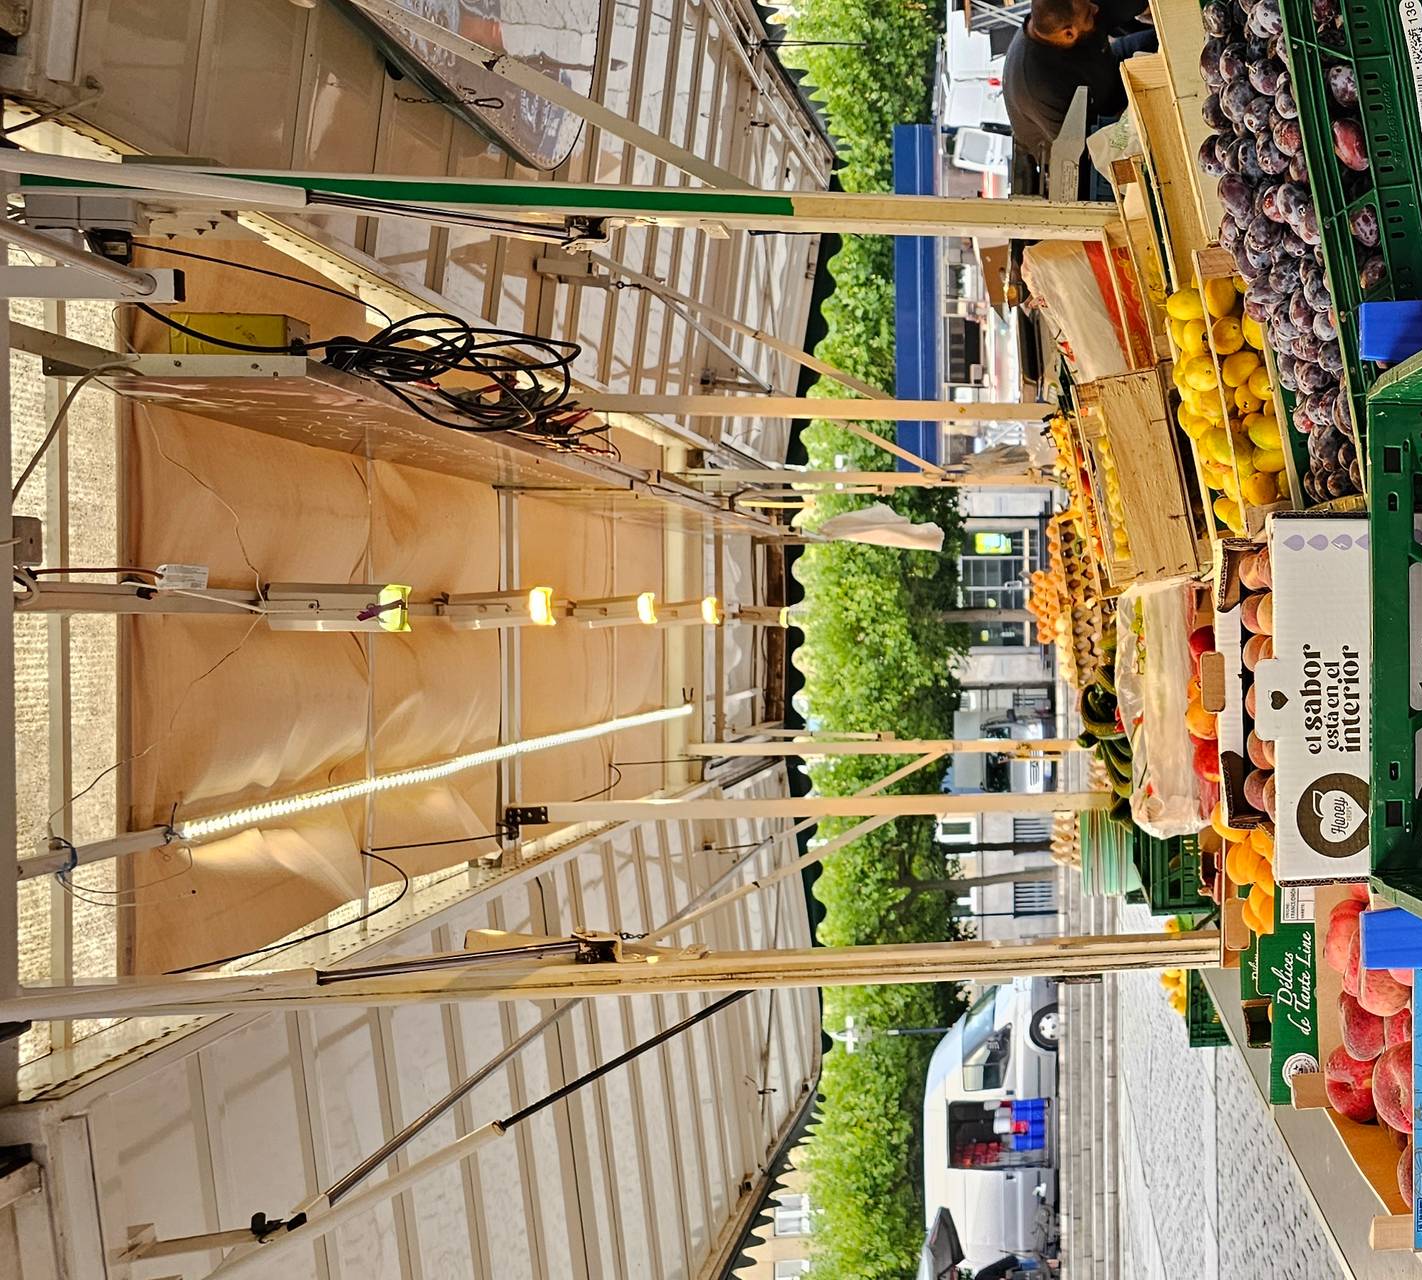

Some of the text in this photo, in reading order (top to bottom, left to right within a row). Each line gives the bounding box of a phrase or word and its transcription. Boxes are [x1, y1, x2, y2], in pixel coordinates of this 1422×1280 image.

[1404, 1, 1418, 24] 136
[1299, 644, 1322, 754] el sabor
[1324, 662, 1340, 749] está en el
[1338, 644, 1360, 752] interior
[1331, 797, 1349, 835] Honey
[1296, 931, 1311, 968] Line
[1271, 952, 1293, 1006] Délices
[1293, 970, 1311, 1012] Tante
[1287, 1014, 1311, 1035] de
